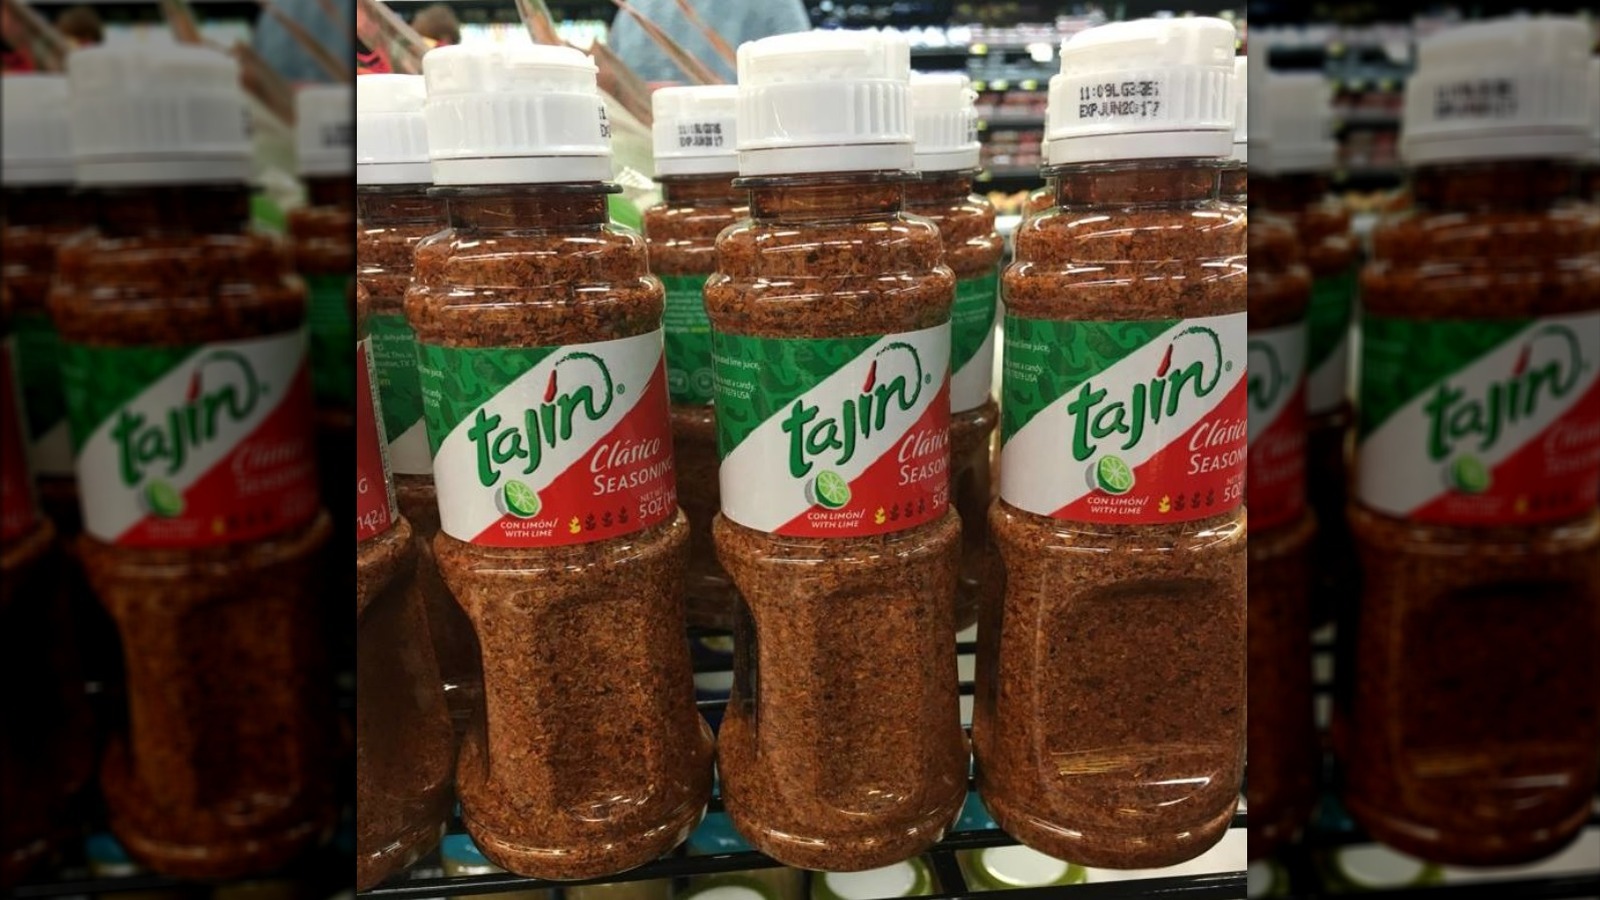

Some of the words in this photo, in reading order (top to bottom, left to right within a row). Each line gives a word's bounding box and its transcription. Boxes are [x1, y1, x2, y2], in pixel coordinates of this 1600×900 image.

[590, 437, 660, 473] Clásico
[1087, 496, 1109, 505] CON
[1091, 506, 1117, 514] WITH
[1119, 506, 1142, 515] LIME
[807, 512, 828, 520] CON
[500, 521, 520, 530] CON
[811, 521, 836, 529] WITH
[838, 520, 859, 529] LIME
[505, 530, 529, 538] WITH
[531, 529, 553, 538] LIME
